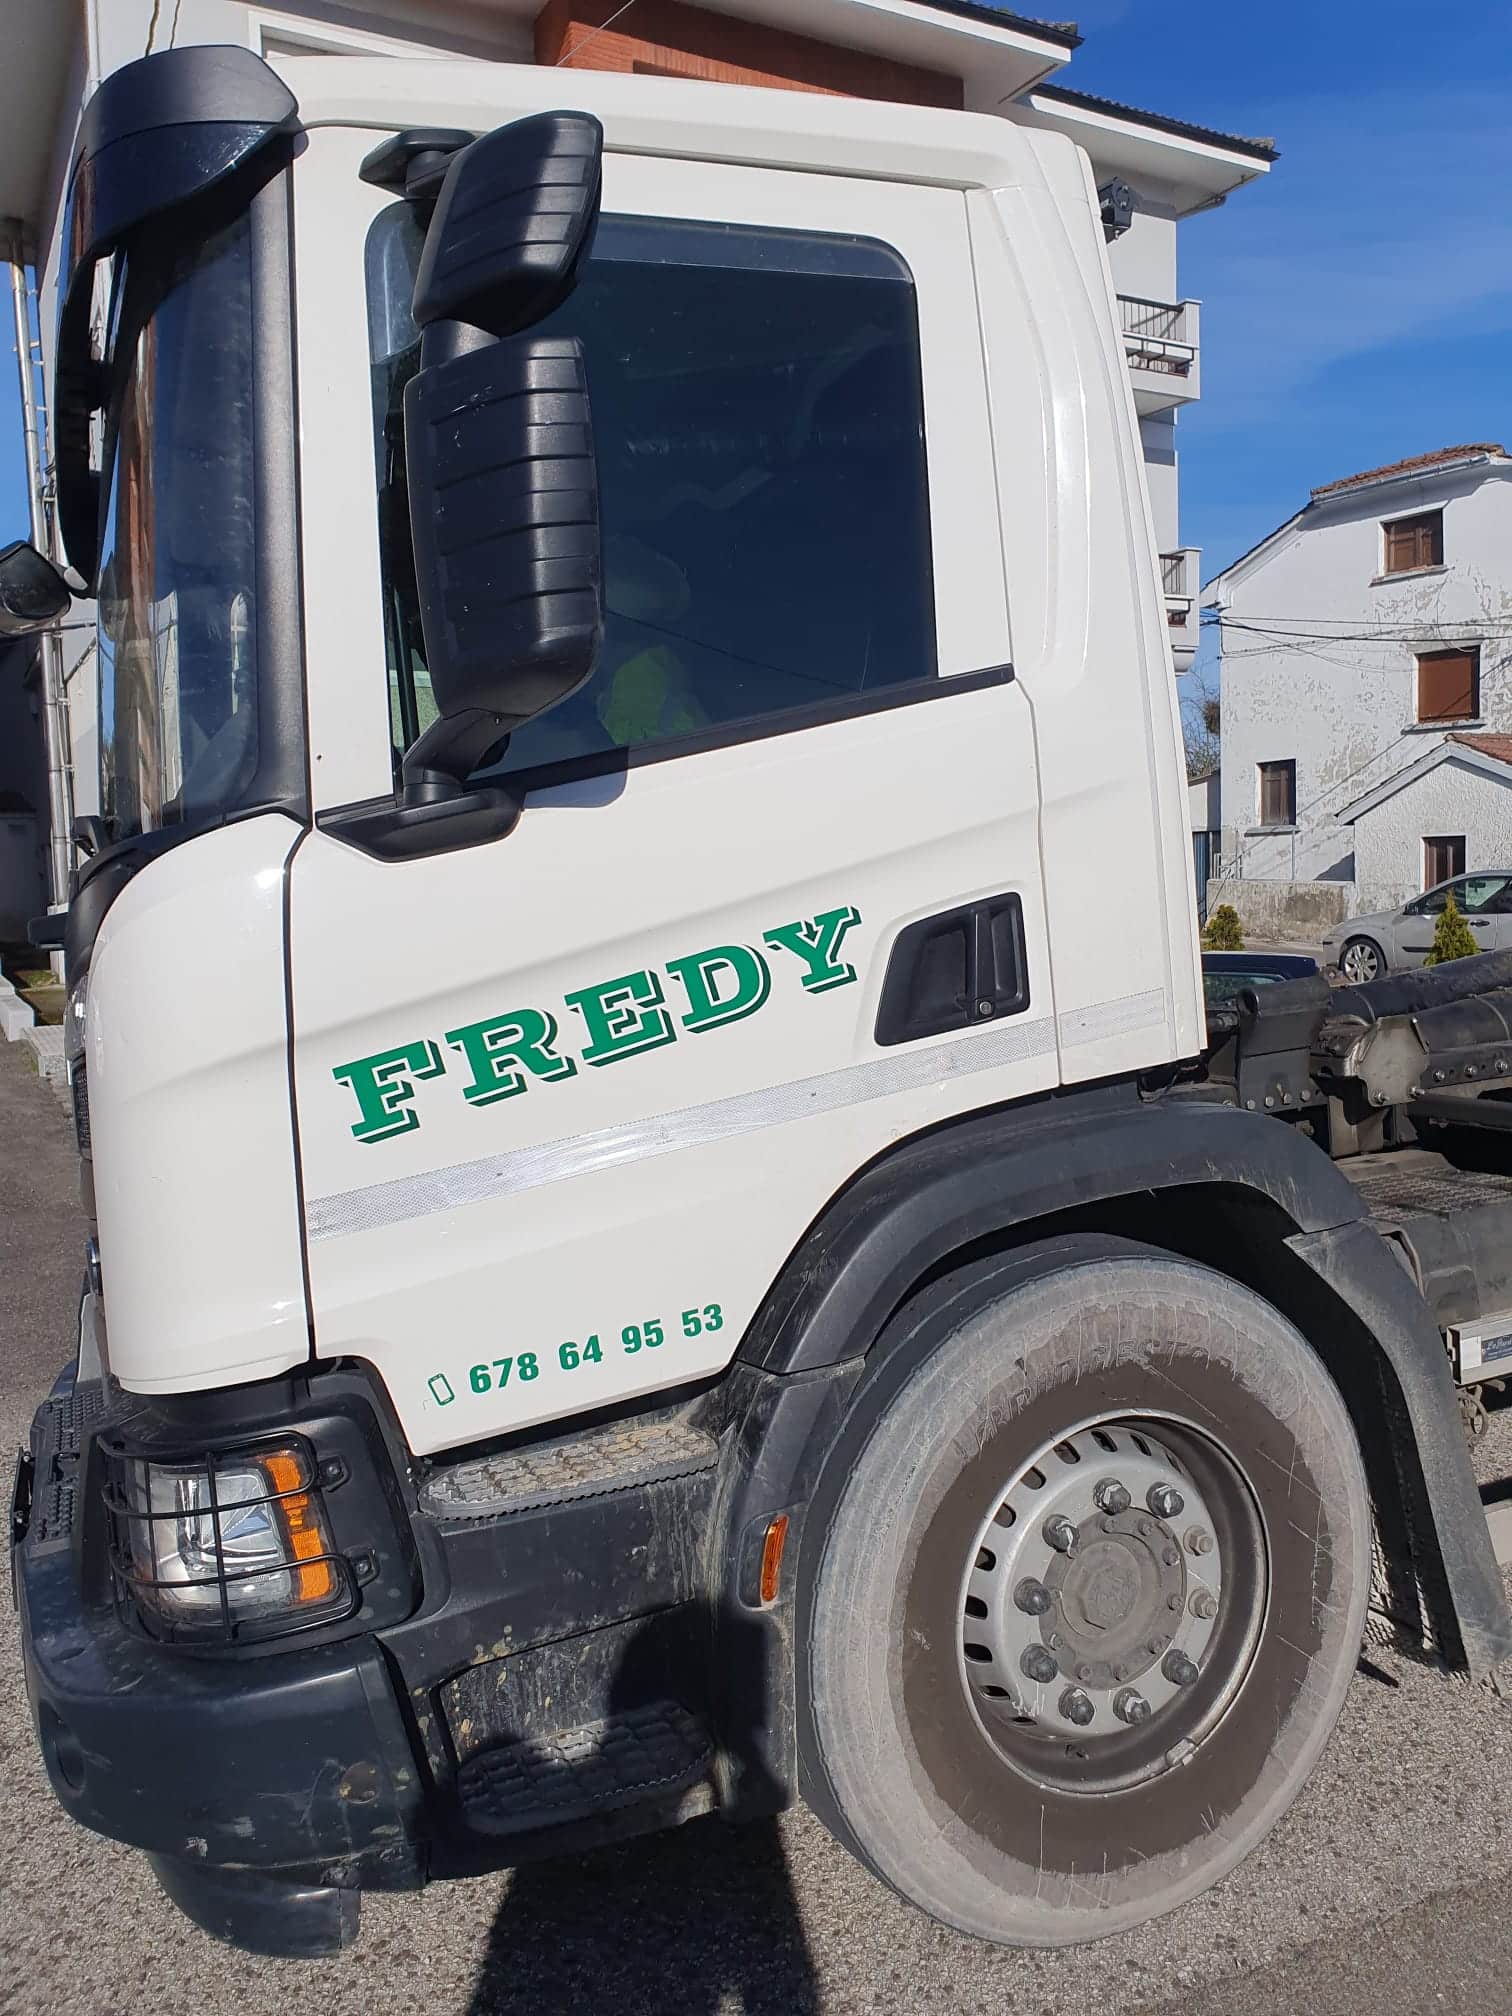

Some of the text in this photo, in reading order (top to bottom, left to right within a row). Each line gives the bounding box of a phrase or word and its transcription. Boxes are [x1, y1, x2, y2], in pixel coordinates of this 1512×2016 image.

[332, 907, 863, 1144] FREDY
[468, 1303, 724, 1394] 678 64 95 53
